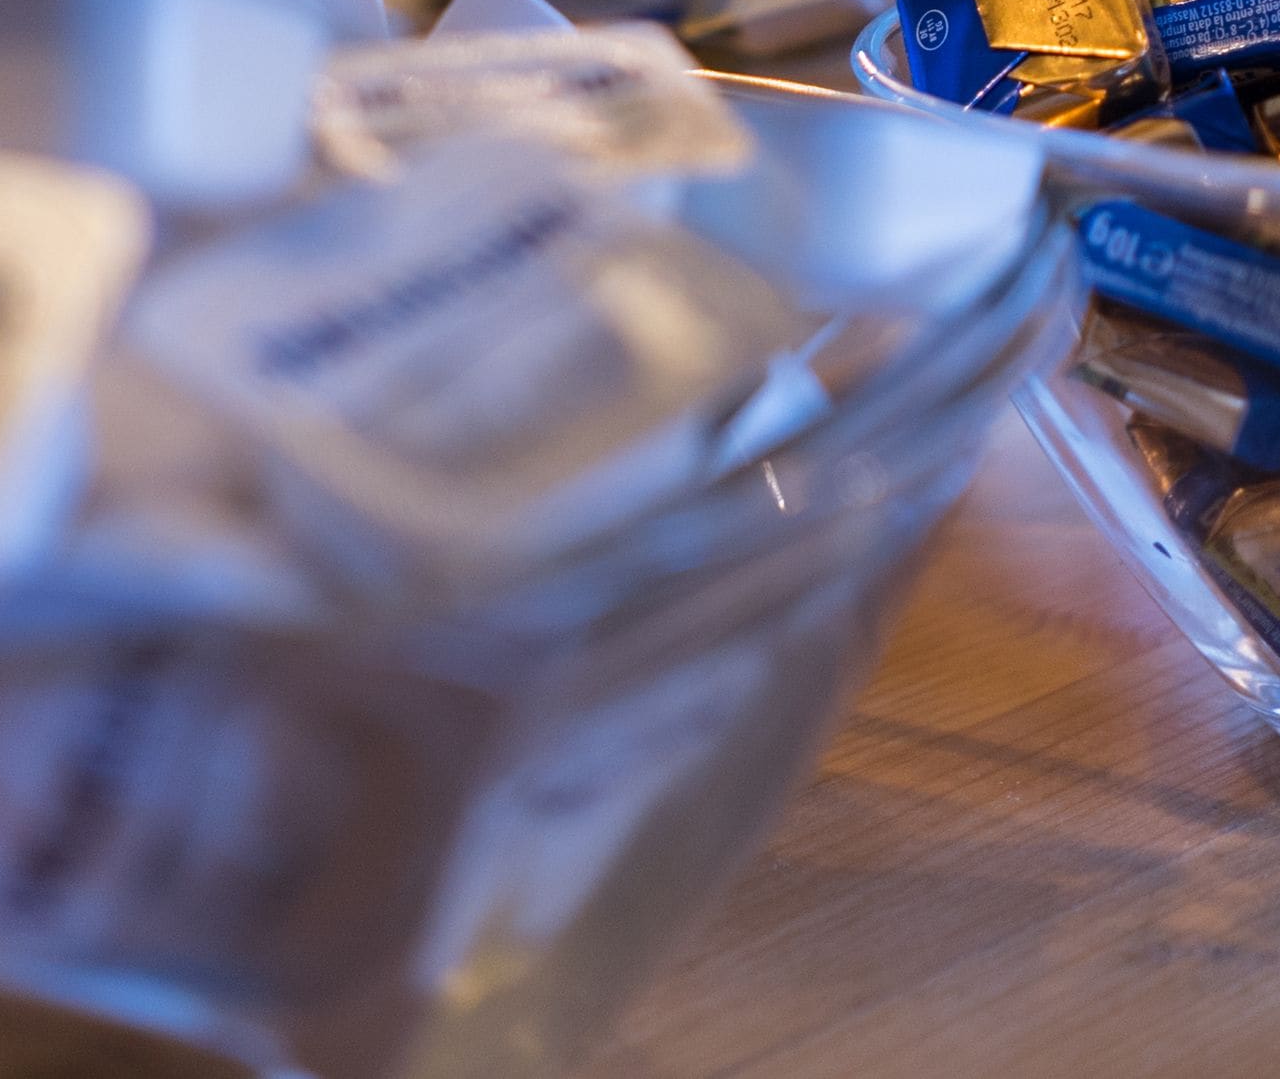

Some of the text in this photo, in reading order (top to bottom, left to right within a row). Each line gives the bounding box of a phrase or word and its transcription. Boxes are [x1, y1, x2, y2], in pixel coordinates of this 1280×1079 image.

[1212, 14, 1225, 27] la
[1223, 6, 1255, 23] entro
[1186, 16, 1212, 33] data
[1196, 29, 1211, 45] Da
